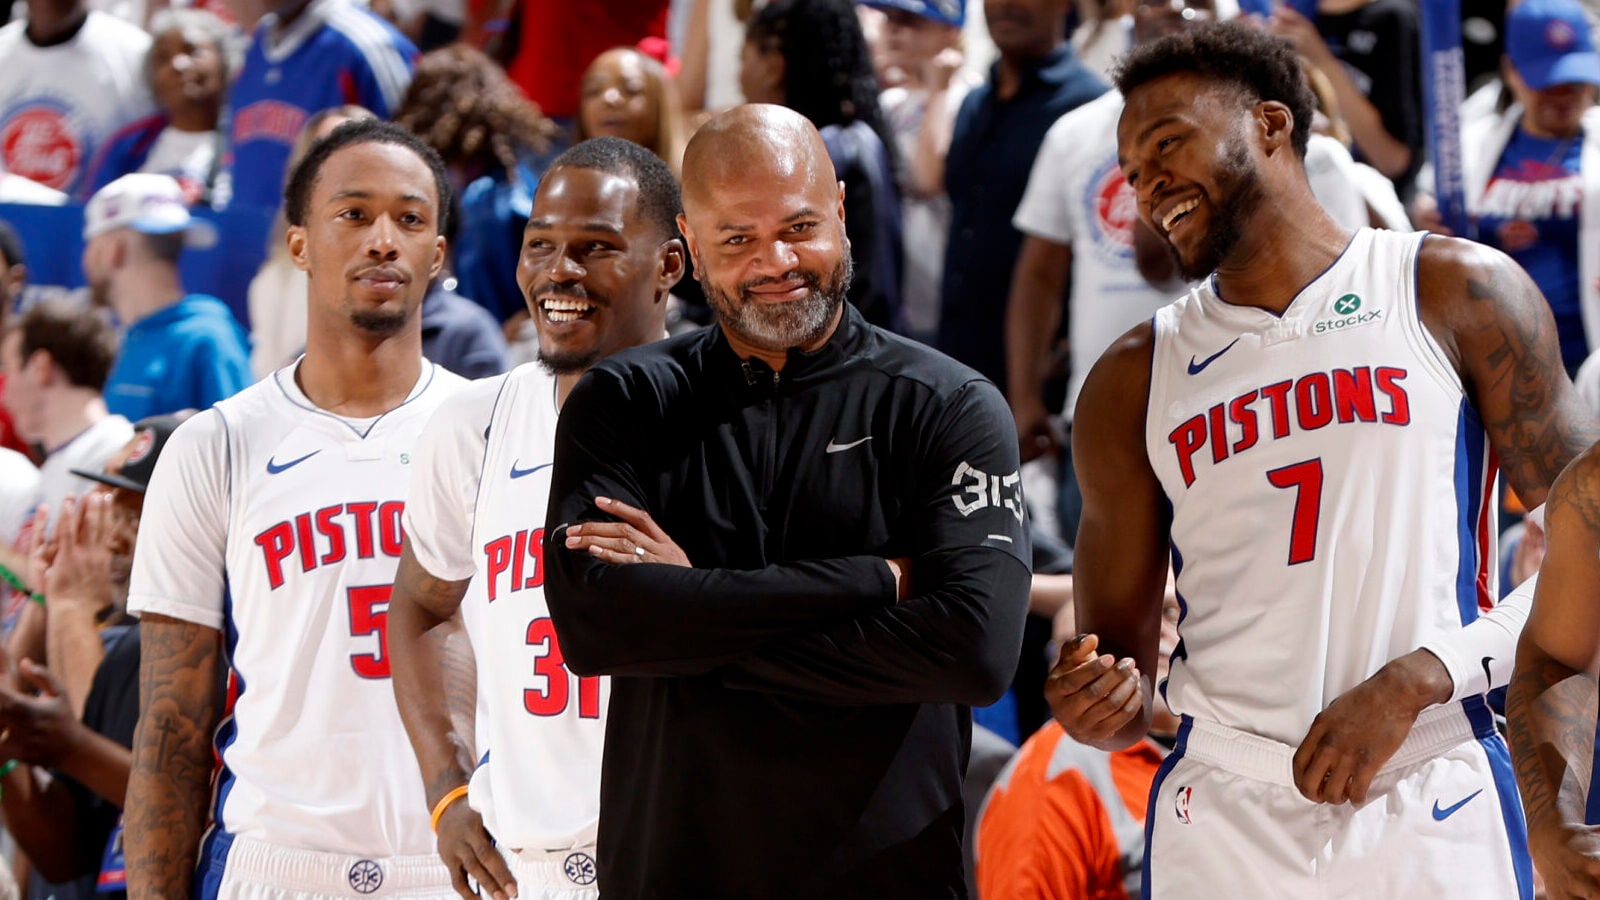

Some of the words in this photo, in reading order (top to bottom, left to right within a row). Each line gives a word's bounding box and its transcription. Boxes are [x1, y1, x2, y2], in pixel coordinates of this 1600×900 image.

[1315, 309, 1382, 333] StockX
[1168, 366, 1411, 489] PISTONS
[951, 460, 1024, 527] 313
[1266, 457, 1324, 566] 7
[254, 501, 405, 591] PISTO
[346, 584, 392, 680] 5
